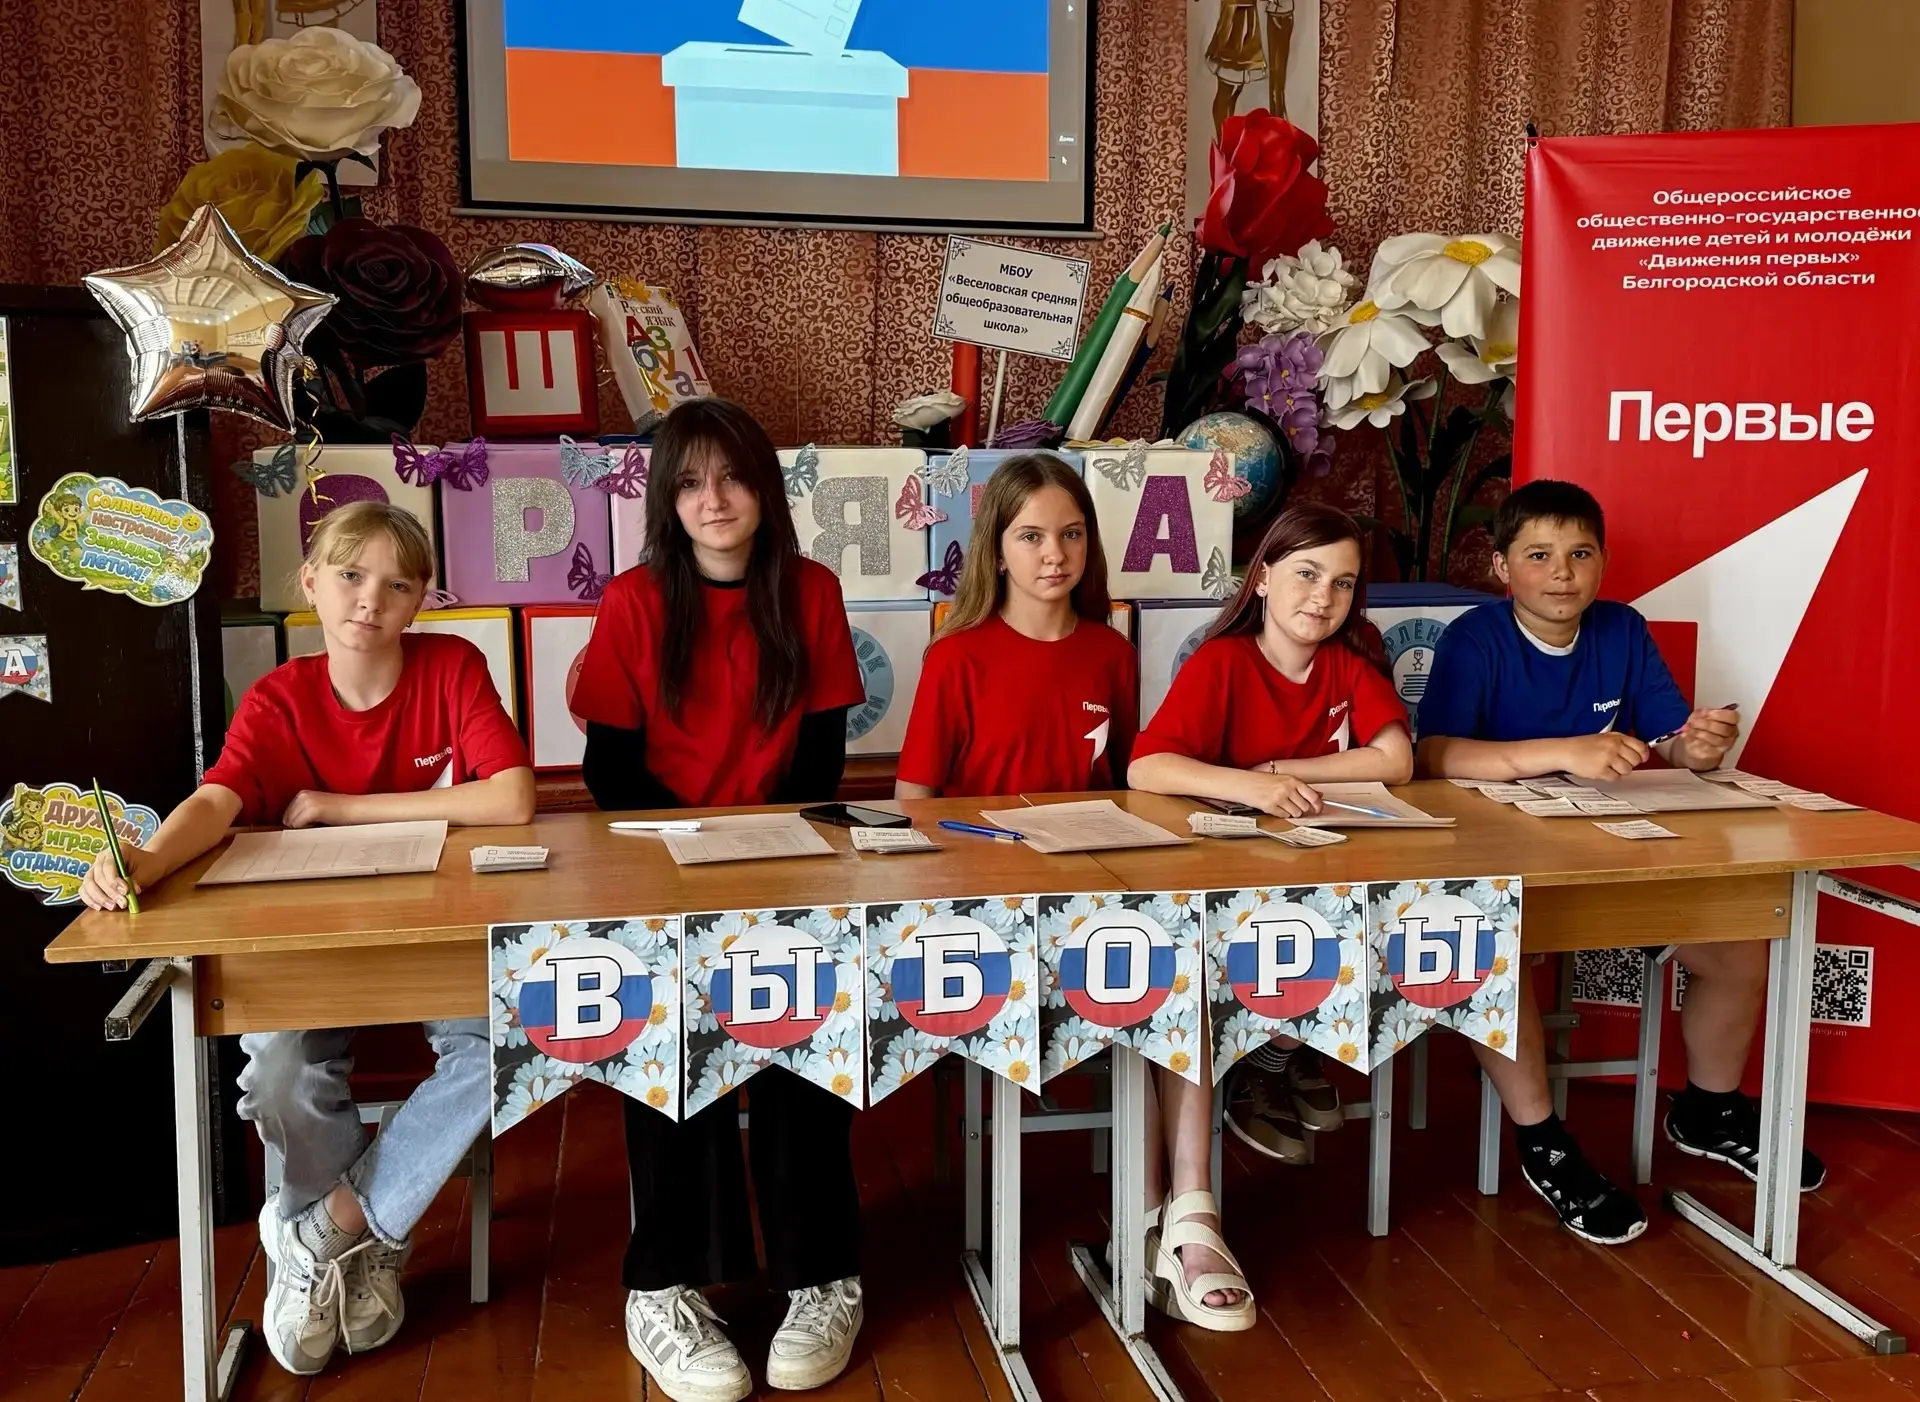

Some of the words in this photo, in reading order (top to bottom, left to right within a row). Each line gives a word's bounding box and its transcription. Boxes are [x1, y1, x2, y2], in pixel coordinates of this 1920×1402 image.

[1652, 186, 1852, 207] Общероссийское
[1576, 207, 1920, 231] общественно-государственно
[1592, 233, 1702, 251] движение
[1705, 229, 1771, 248] детей
[1775, 231, 1789, 245] и
[1794, 226, 1912, 246] молодёжи
[999, 263, 1034, 279] МБОУ
[1639, 253, 1761, 270] «Движения
[1766, 250, 1860, 268] первых»
[948, 274, 1028, 298] «Веселовская
[1031, 290, 1078, 307] средняя
[1622, 272, 1779, 291] Белгородской
[1783, 270, 1876, 287] области
[620, 300, 664, 316] Русский
[945, 292, 1074, 325] общеобразовательная
[983, 318, 1029, 335] школа»
[479, 330, 582, 416] Ш
[682, 345, 708, 382] 1
[1608, 390, 1876, 459] Первые
[86, 488, 182, 530] Солнечное
[91, 511, 190, 549] настроение!
[84, 527, 162, 566] Зарядись
[80, 551, 152, 584] летом!
[46, 829, 110, 854] играе
[12, 851, 91, 878] отдыхае
